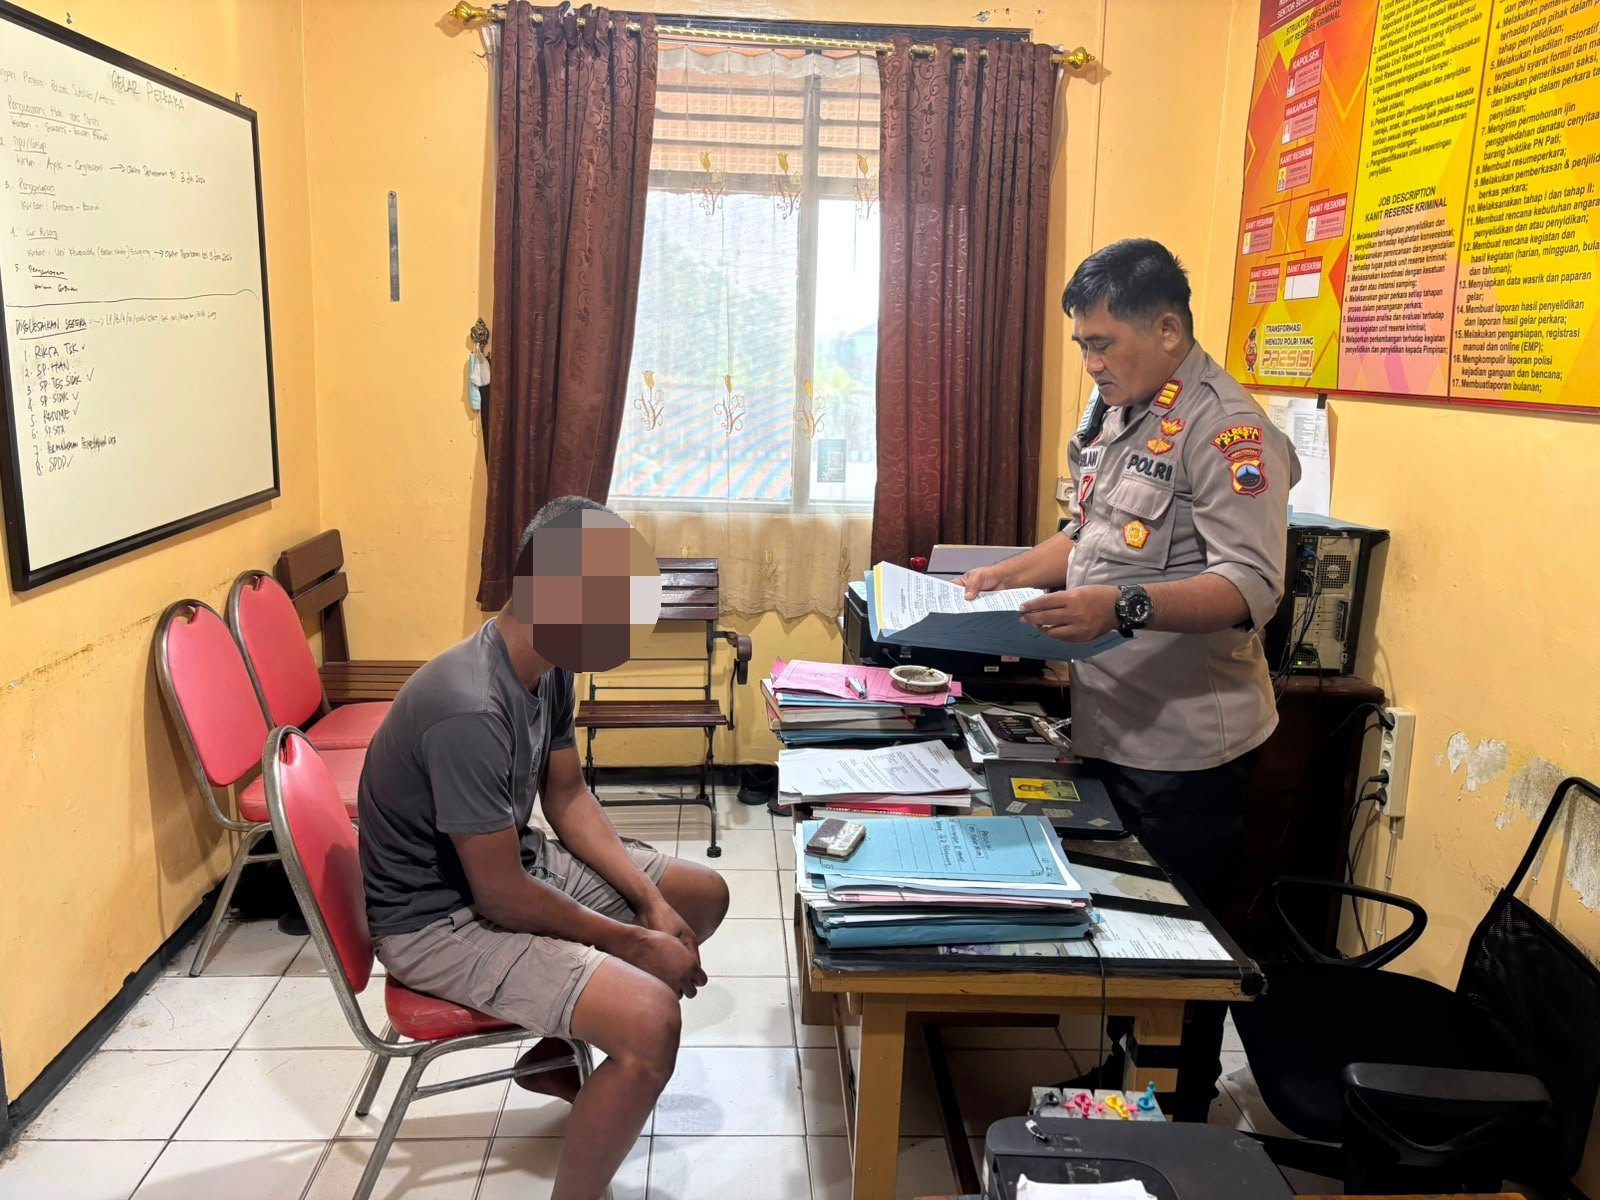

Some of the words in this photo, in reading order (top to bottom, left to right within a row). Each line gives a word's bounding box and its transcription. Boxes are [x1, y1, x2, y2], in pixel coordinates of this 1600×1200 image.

[1286, 15, 1309, 35] STRUKTUR
[1500, 24, 1529, 41] terhadap
[1531, 17, 1546, 31] para
[1548, 7, 1568, 25] pihak
[1503, 8, 1537, 26] Melakukan
[1284, 36, 1294, 47] UNIT
[1295, 23, 1315, 39] RESERSE
[1316, 11, 1340, 29] KRIMINAL
[1499, 41, 1516, 54] tahap
[1518, 24, 1564, 47] penyelidikan;
[1497, 50, 1531, 67] Melakukan
[1533, 38, 1562, 55] keadilan
[1564, 22, 1599, 43] restoratif
[1293, 49, 1320, 69] KAPOLSEK
[1495, 63, 1526, 81] terpenuhi
[1527, 55, 1548, 71] syarat
[1550, 49, 1572, 62] formil
[1573, 43, 1587, 54] dan
[1493, 77, 1527, 94] Melakukan
[1529, 61, 1574, 83] pemeriksaan
[1576, 51, 1598, 67] saksi,
[1491, 98, 1502, 108] dan
[1504, 87, 1536, 104] tersangka
[1539, 80, 1560, 96] dalam
[1562, 70, 1590, 88] perkara
[1286, 98, 1317, 114] WAKAPOLSEK
[1489, 104, 1526, 123] penyidikan;
[1488, 119, 1516, 134] Mengirim
[1518, 106, 1562, 128] permohonan
[1564, 102, 1576, 115] ijin
[1485, 126, 1534, 149] penggeledahan
[1537, 120, 1565, 134] danatau
[1567, 110, 1600, 126] cenyitaa
[1484, 149, 1506, 160] barang
[1533, 138, 1543, 149] PN
[1545, 133, 1561, 146] Pati;
[1481, 173, 1514, 187] Melakukan
[1515, 163, 1562, 181] pemberkasan
[1564, 159, 1569, 169] &
[1572, 154, 1600, 170] penjilid
[1482, 160, 1511, 174] Membuat
[1378, 196, 1390, 207] JOB
[1392, 185, 1436, 203] DESCRIPTION
[1478, 198, 1521, 212] Melaksanakan
[1523, 194, 1542, 203] tahap
[1549, 190, 1562, 200] dan
[1564, 186, 1585, 196] tahap
[1479, 189, 1499, 199] berkas
[1501, 183, 1528, 197] perkara;
[1365, 210, 1383, 222] KANIT
[1384, 204, 1413, 218] RESERSE
[1415, 197, 1447, 210] KRIMINAL
[1476, 213, 1504, 224] Membuat
[1505, 211, 1532, 220] rencana
[1534, 202, 1571, 218] kebutuhan
[1573, 199, 1600, 211] angara
[1386, 226, 1404, 238] kegiatan
[1405, 221, 1434, 234] penyelidikan
[1474, 226, 1513, 239] penyelidikan
[1515, 223, 1527, 232] dan
[1546, 215, 1588, 229] penyidikan;
[1472, 240, 1500, 250] Membuat
[1502, 238, 1528, 247] rencana
[1530, 232, 1559, 245] kegiatan
[1562, 230, 1575, 239] dan
[1471, 253, 1485, 263] hasil
[1487, 252, 1514, 263] kegiatan
[1516, 248, 1540, 260] (harian,
[1542, 244, 1580, 256] mingguan,
[1583, 241, 1600, 251] bula
[1482, 263, 1512, 274] tahunan);
[1468, 278, 1504, 290] Menyiapkan
[1523, 274, 1544, 283] wasrik
[1546, 273, 1559, 282] dan
[1561, 271, 1592, 283] paparan
[1466, 305, 1494, 313] Membuat
[1495, 303, 1519, 313] laporan
[1521, 302, 1537, 311] hasil
[1539, 300, 1584, 312] penyelidikan
[1467, 293, 1484, 303] gelar;
[1266, 324, 1301, 332] TRANSFORMASI
[1464, 318, 1476, 326] dan
[1477, 317, 1500, 327] laporan
[1503, 316, 1518, 324] hasil
[1520, 316, 1536, 326] gelar
[1538, 315, 1567, 325] perkara;
[1498, 330, 1544, 340] pengarsiapan,
[1546, 328, 1580, 339] registrasi
[1463, 343, 1485, 351] manual
[1500, 343, 1519, 351] online
[1521, 342, 1543, 353] (EMP);
[1262, 350, 1313, 367] PRESISI
[1463, 355, 1505, 365] Mengkompulir
[1507, 356, 1532, 365] laporan
[1534, 356, 1552, 366] polisi
[1462, 367, 1486, 377] kejadian
[1488, 370, 1515, 378] ganguan
[1517, 369, 1529, 377] dan
[1531, 370, 1562, 381] bencana;
[1513, 381, 1542, 393] bulanan;
[1215, 427, 1259, 445] POLRESTA
[1224, 435, 1256, 444] PATI
[1127, 454, 1172, 481] POLRI
